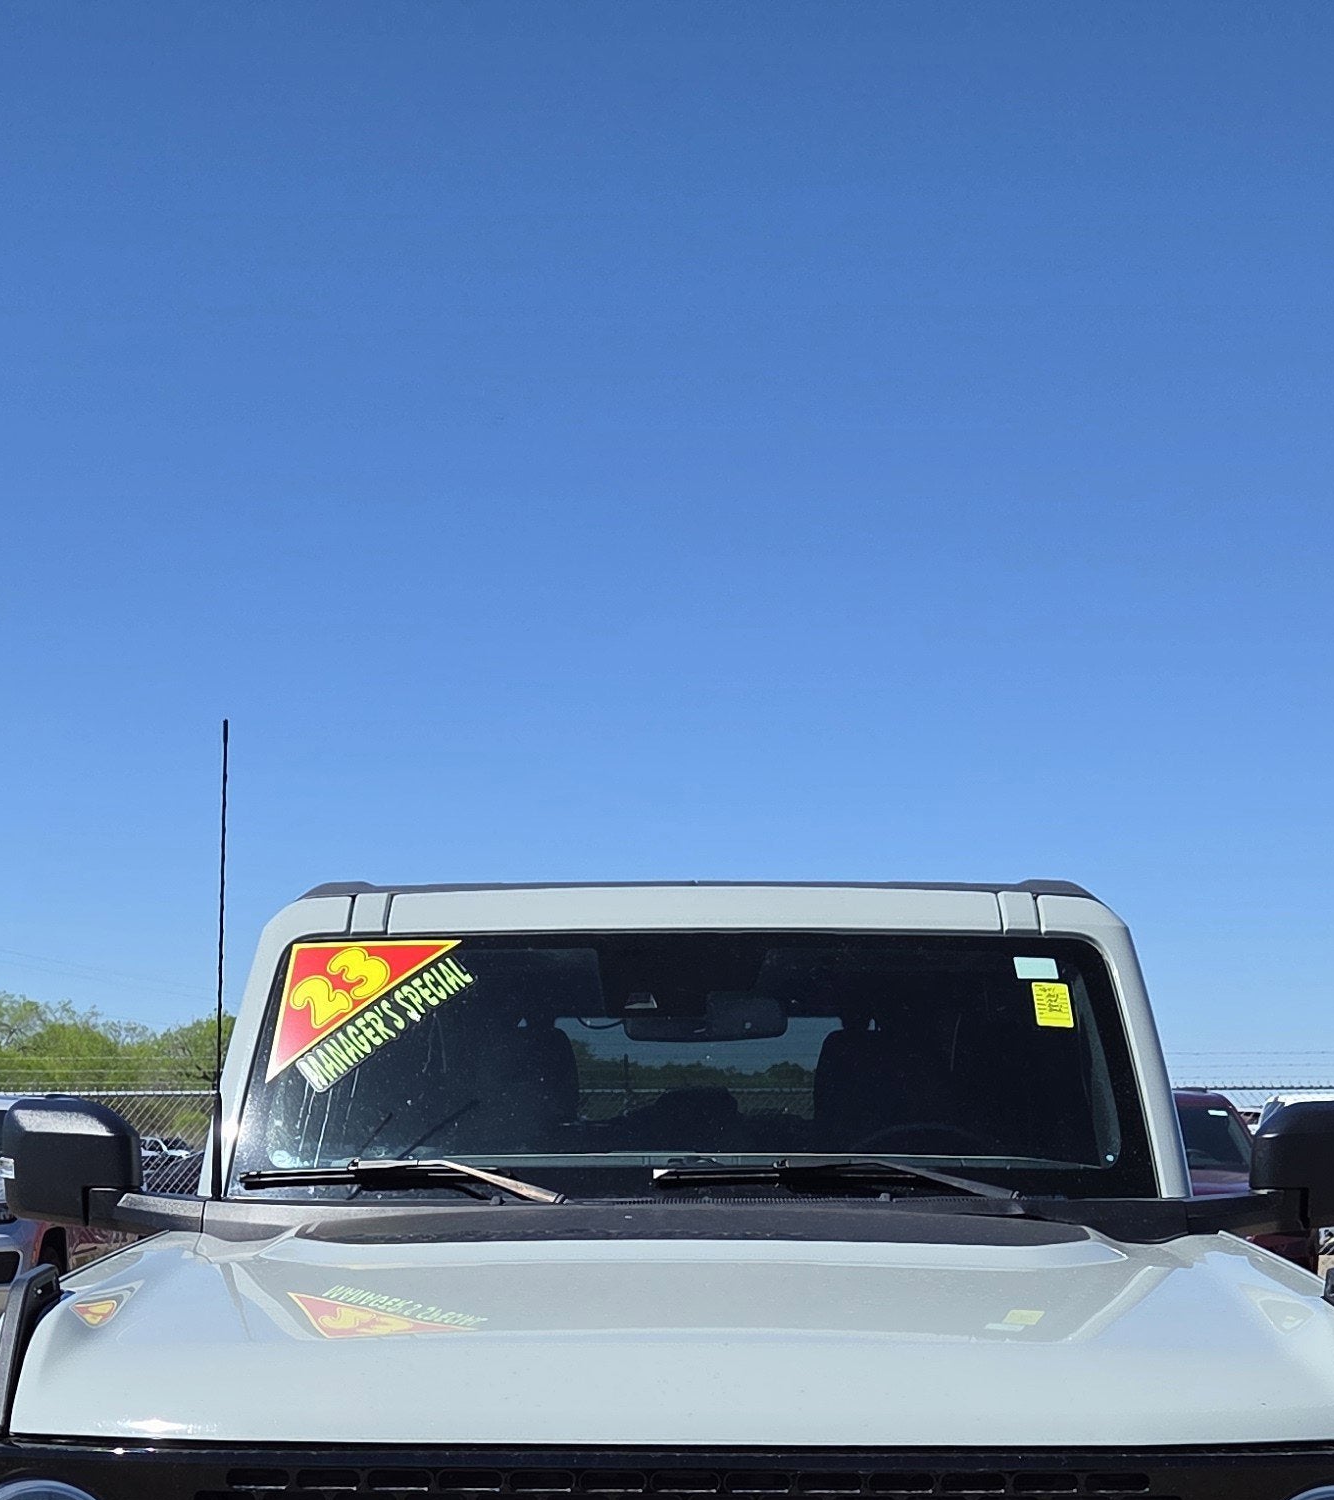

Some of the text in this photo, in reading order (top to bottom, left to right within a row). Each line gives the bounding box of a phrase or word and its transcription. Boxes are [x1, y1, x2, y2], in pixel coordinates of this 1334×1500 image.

[290, 946, 390, 1028] 23
[296, 957, 473, 1090] MANAGER'S SPECIAL
